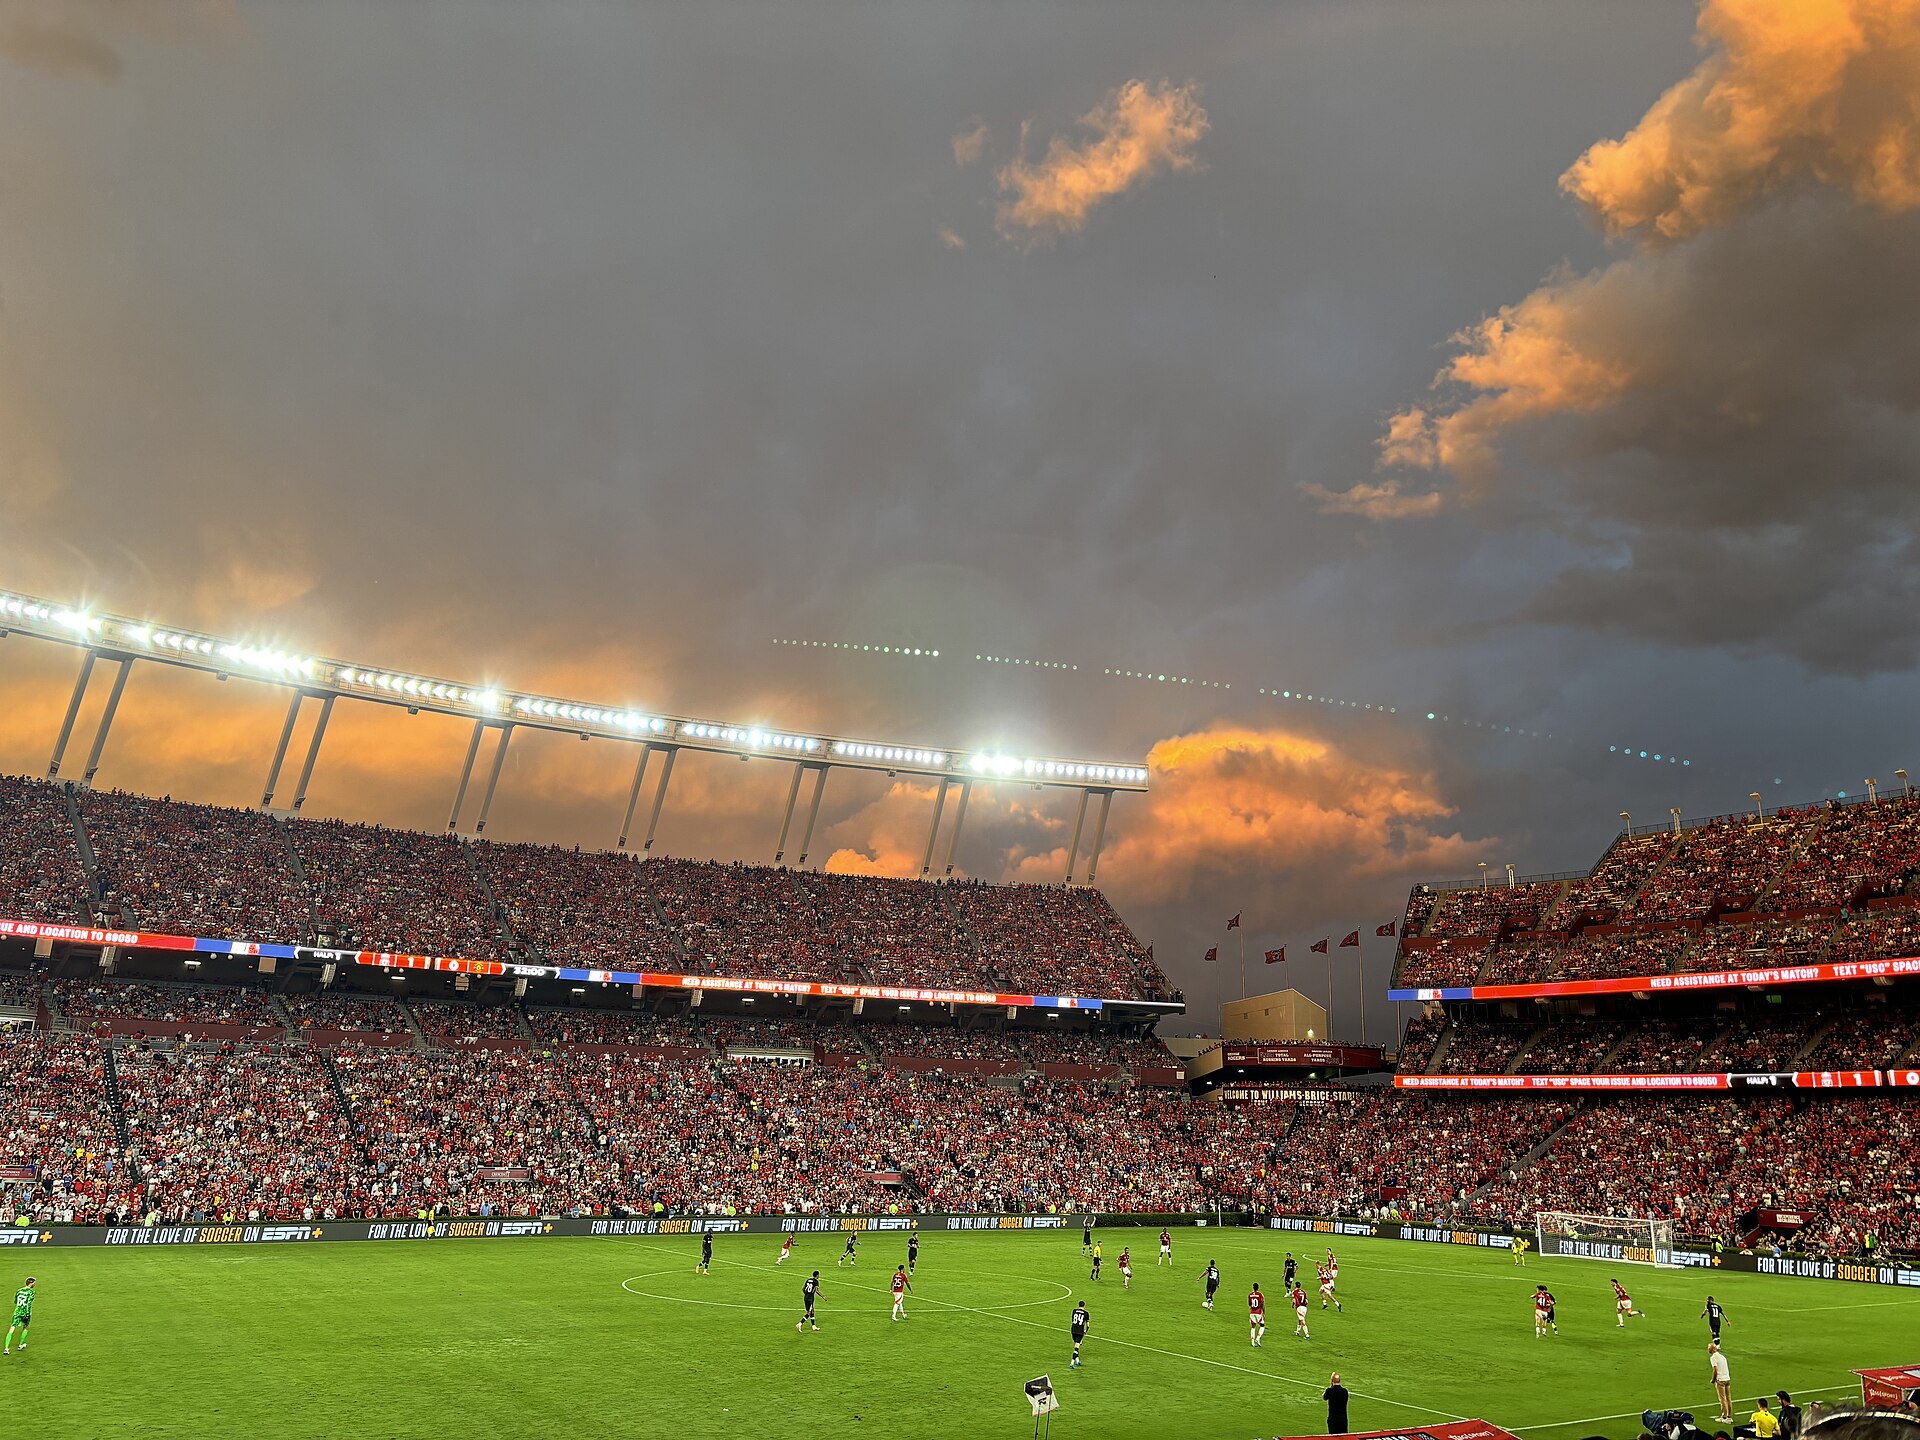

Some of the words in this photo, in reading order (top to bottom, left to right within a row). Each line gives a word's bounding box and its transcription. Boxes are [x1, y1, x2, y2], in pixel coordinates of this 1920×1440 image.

[16, 924, 38, 937] AND
[39, 925, 89, 941] LOCATION
[91, 930, 104, 941] TO
[408, 957, 414, 968] 1
[1650, 977, 1673, 988] NEED
[1673, 974, 1726, 986] ASSISTANCE
[1727, 973, 1739, 983] AT
[1740, 970, 1780, 982] TODAY'S
[1780, 968, 1819, 980] MATCH?
[1833, 965, 1858, 977] TEXT
[1859, 963, 1890, 976] "USC"
[1892, 960, 1920, 972] SPAC
[682, 977, 701, 987] NEED
[701, 978, 743, 990] ASSISTANCE
[743, 980, 754, 990] AT
[755, 981, 783, 991] TODAY'S
[783, 982, 811, 993] MATCH?
[820, 985, 837, 995] TEXT
[1402, 1078, 1419, 1086] NEED
[1420, 1078, 1459, 1086] ASSISTANCE
[1460, 1078, 1469, 1086] AT
[1470, 1078, 1497, 1086] TODAY'S
[1497, 1078, 1524, 1086] MATCH?
[1532, 1078, 1548, 1086] TEXT
[1570, 1078, 1591, 1086] SPACE
[1591, 1077, 1610, 1086] YOUR
[1610, 1077, 1630, 1086] ISSUE
[1631, 1077, 1646, 1086] AND
[1646, 1077, 1681, 1086] LOCATION
[1682, 1077, 1691, 1086] TO
[1853, 1073, 1862, 1086] 1
[1906, 1072, 1920, 1086] 0
[1224, 1090, 1249, 1099] WELCOME
[1250, 1090, 1259, 1099] TO
[590, 1221, 609, 1235] FOR
[609, 1221, 626, 1235] THE
[626, 1220, 648, 1235] LOVE
[648, 1220, 660, 1234] OF
[659, 1220, 690, 1234] SOCCER
[690, 1220, 703, 1233] ON
[781, 1219, 796, 1231] FOR
[797, 1218, 811, 1231] THE
[811, 1218, 830, 1231] LOVE
[830, 1218, 840, 1231] OF
[840, 1218, 868, 1231] SOCCER
[868, 1218, 878, 1230] ON
[947, 1218, 960, 1230] FOR
[961, 1217, 973, 1230] THE
[973, 1217, 990, 1229] LOVE
[990, 1217, 999, 1229] OF
[999, 1217, 1023, 1229] SOCCER
[1023, 1217, 1033, 1229] ON
[1270, 1217, 1281, 1229] FOR
[1281, 1218, 1291, 1230] THE
[1291, 1219, 1305, 1231] LOVE
[1305, 1220, 1313, 1232] OF
[1313, 1221, 1334, 1233] SOCCER
[1334, 1222, 1343, 1234] ON
[105, 1228, 129, 1244] FOR
[130, 1228, 151, 1244] THE
[152, 1228, 182, 1244] LOVE
[182, 1227, 200, 1243] OF
[199, 1227, 243, 1243] SOCCER
[243, 1226, 260, 1242] ON
[367, 1224, 389, 1239] FOR
[389, 1224, 408, 1238] THE
[408, 1223, 430, 1238] LOV
[434, 1222, 448, 1237] OF
[448, 1222, 485, 1236] SOCCER
[485, 1222, 501, 1236] ON
[1400, 1227, 1413, 1240] FOR
[1413, 1228, 1424, 1241] THE
[1425, 1229, 1441, 1242] LOVE
[1442, 1230, 1451, 1243] OF
[1451, 1231, 1477, 1245] SOCCER
[1478, 1233, 1488, 1246] ON
[1559, 1240, 1574, 1254] FOR
[1574, 1241, 1590, 1256] THE
[1590, 1243, 1612, 1259] LOVE
[1613, 1244, 1623, 1259] OF
[1656, 1249, 1668, 1264] ON
[1757, 1257, 1775, 1273] FOR
[1776, 1258, 1795, 1275] THE
[1796, 1260, 1821, 1277] LOVE
[1822, 1262, 1835, 1279] OF
[1837, 1264, 1877, 1283] SOCCER
[1879, 1267, 1894, 1284] ON
[893, 1277, 902, 1289] 25
[1251, 1298, 1259, 1308] 10
[1300, 1294, 1305, 1303] 7
[1073, 1313, 1085, 1325] 84
[1712, 1307, 1719, 1318] 11
